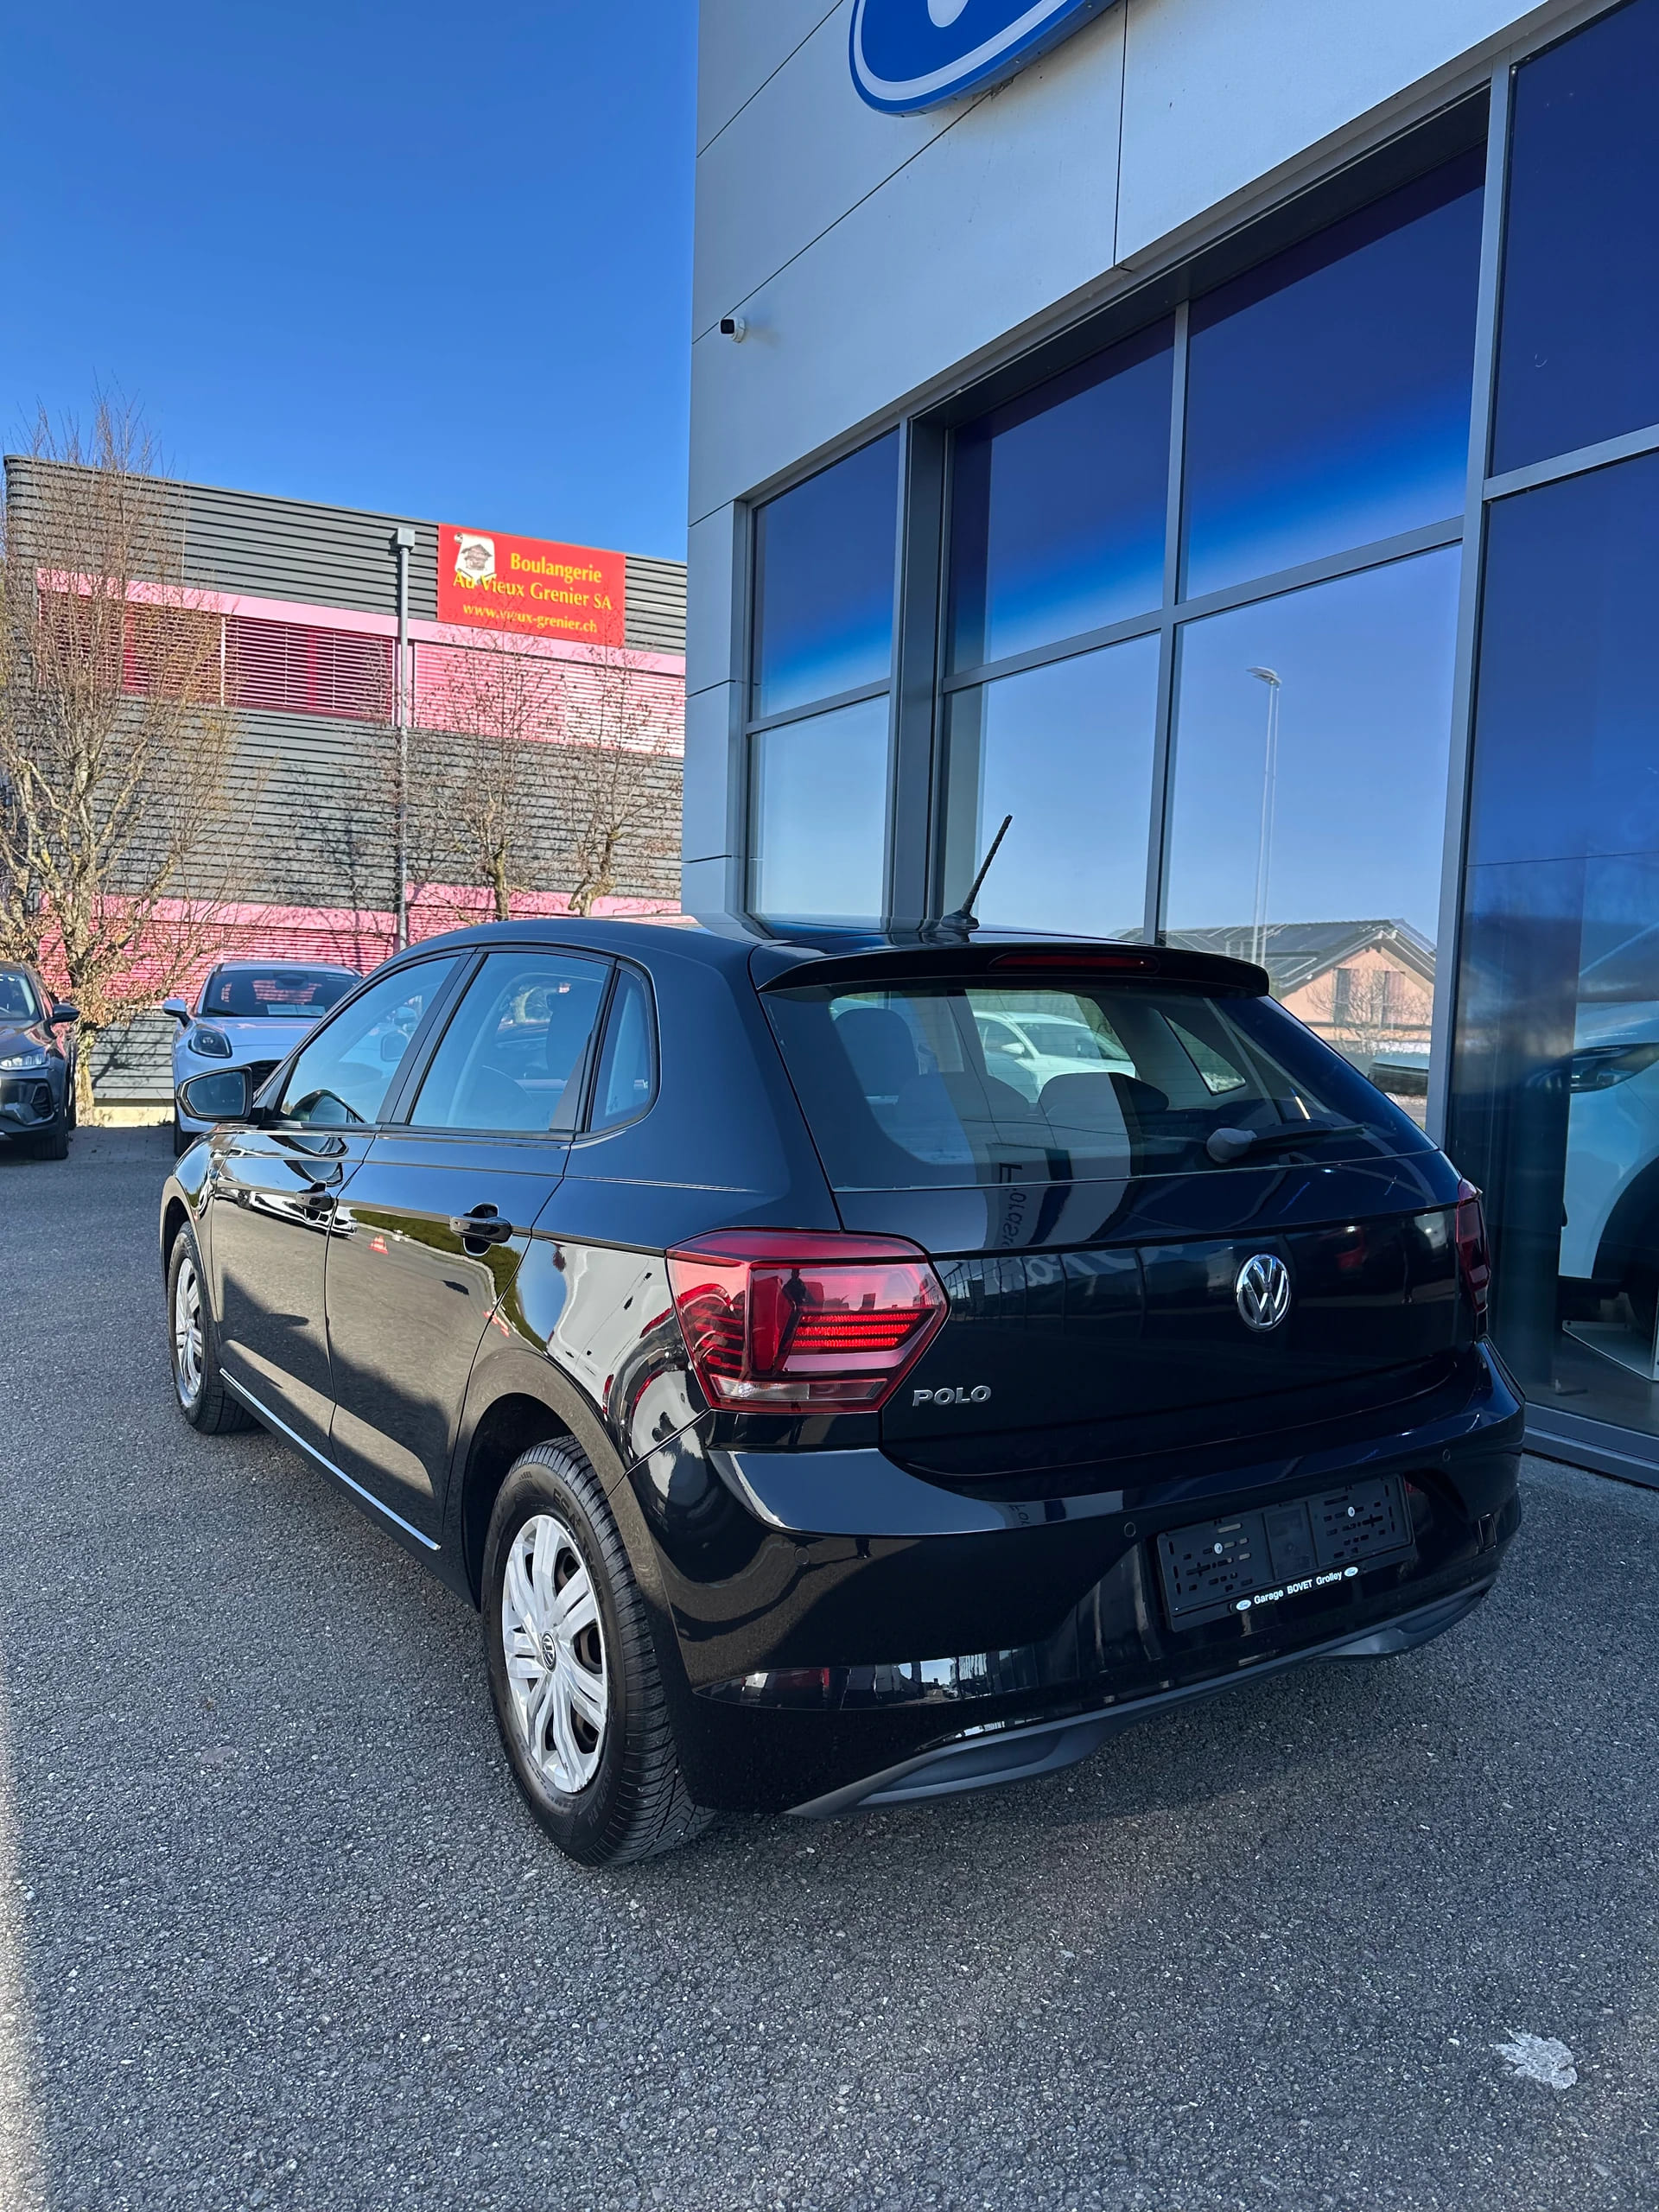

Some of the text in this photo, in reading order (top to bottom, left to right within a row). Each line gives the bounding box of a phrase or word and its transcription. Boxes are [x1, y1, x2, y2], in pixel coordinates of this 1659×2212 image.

[510, 552, 602, 584] Boulangerie
[453, 570, 612, 610] Au Vieux Grenier SA
[462, 603, 598, 633] www.vieux-grenier.ch
[912, 1385, 992, 1407] POLO
[1254, 1589, 1284, 1605] Garage
[1287, 1579, 1313, 1595] BOVET
[1315, 1571, 1343, 1586] Grolley
